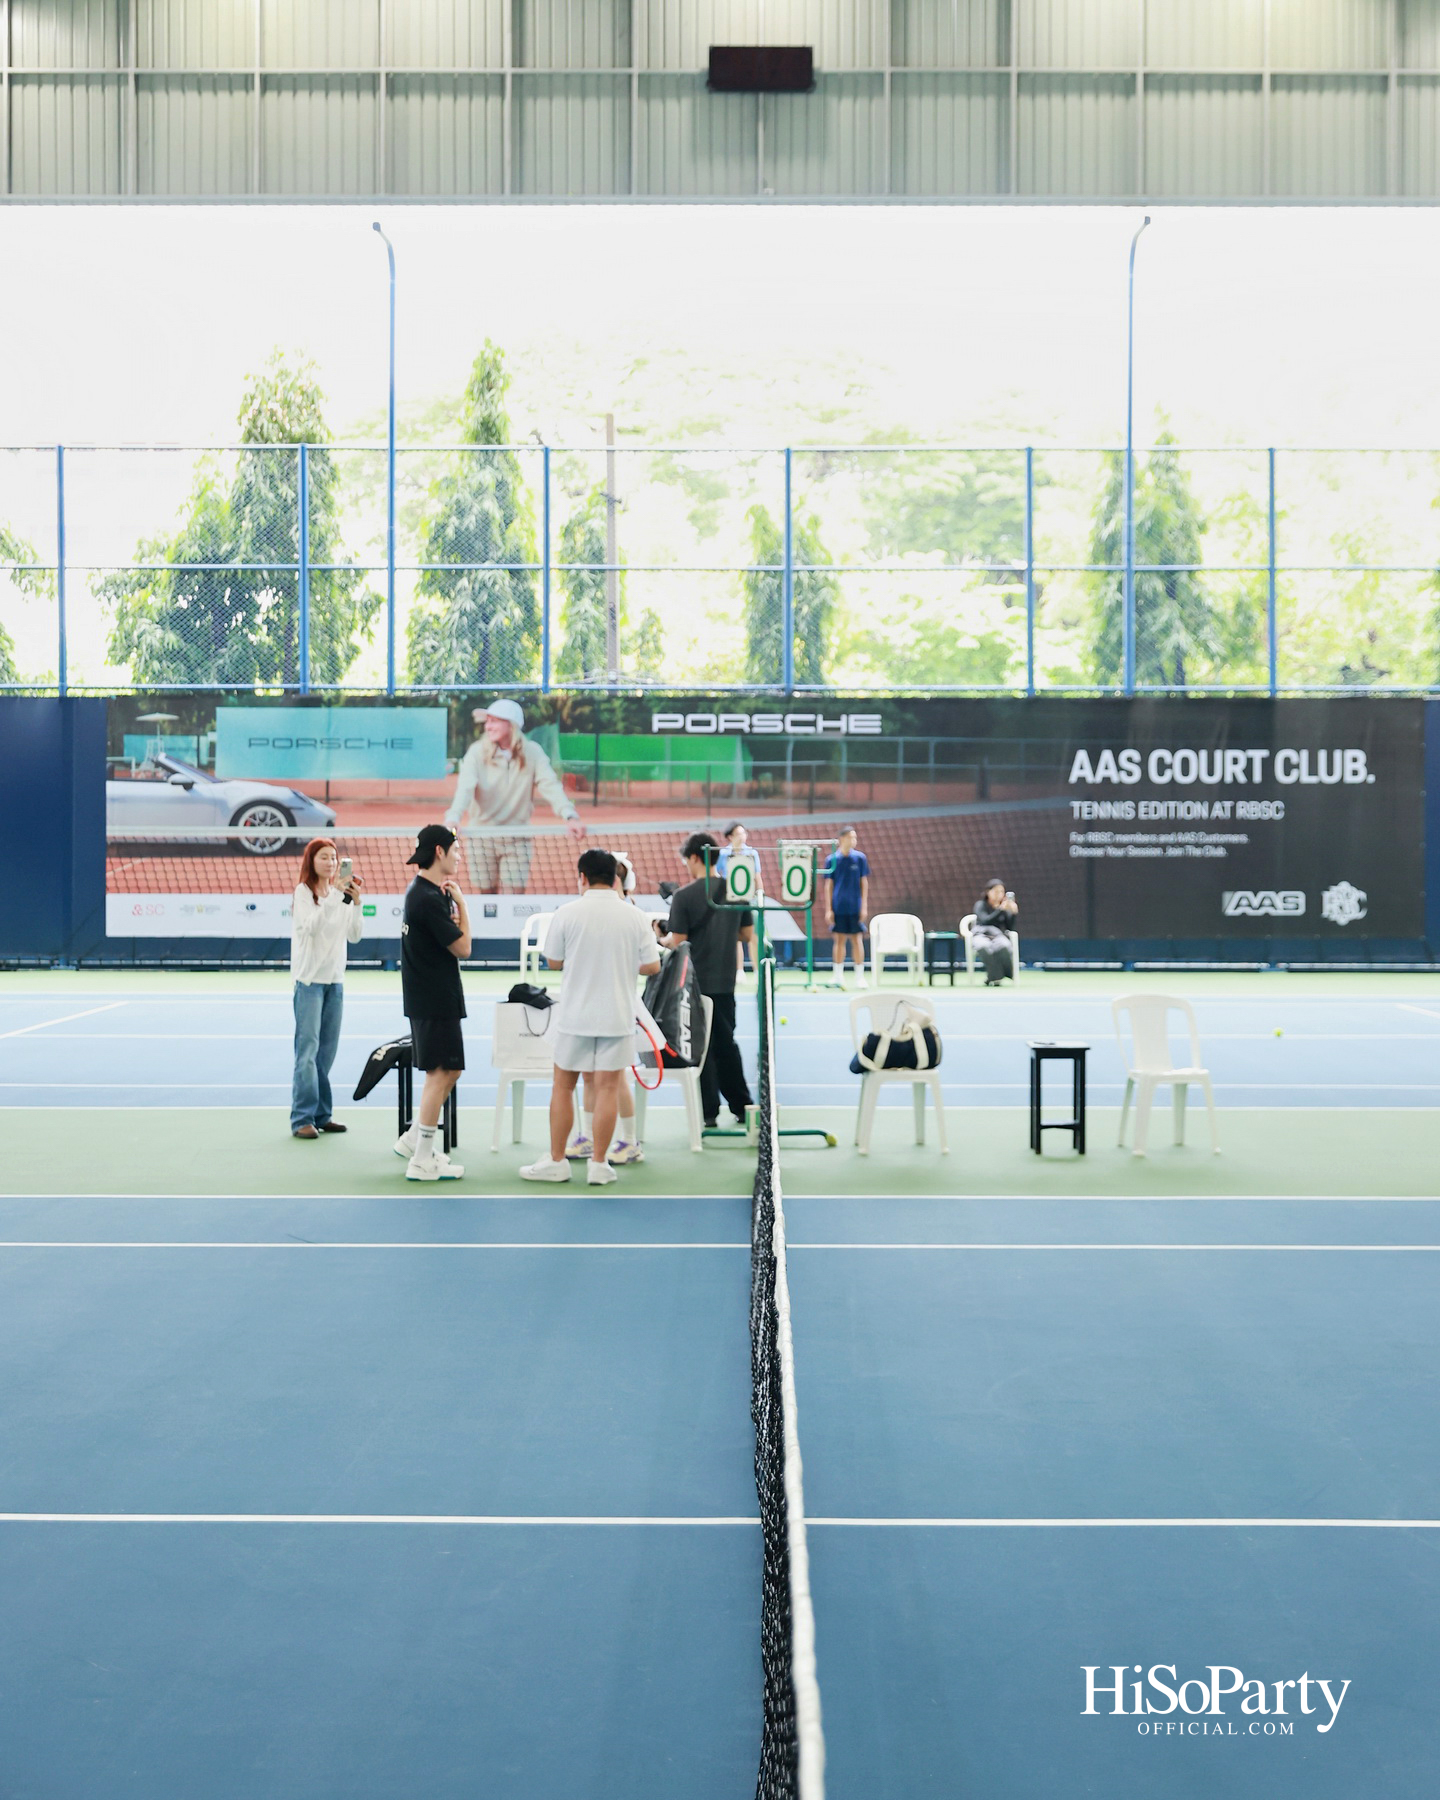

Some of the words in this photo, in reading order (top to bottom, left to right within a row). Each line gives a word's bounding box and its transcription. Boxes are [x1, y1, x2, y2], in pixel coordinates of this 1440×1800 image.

[652, 713, 882, 735] PORSCHE
[248, 738, 413, 750] PORSCHE
[1069, 749, 1142, 785] AAS
[1147, 749, 1270, 785] COURT
[1274, 749, 1376, 785] CLUB.
[1070, 801, 1136, 821] TENNIS
[1138, 801, 1209, 821] EDITION
[1210, 801, 1235, 821] AT
[1236, 801, 1285, 821] RBSC
[730, 865, 751, 896] 0
[786, 865, 807, 896] 0
[1222, 890, 1306, 917] AAS
[680, 987, 692, 1060] HEAD
